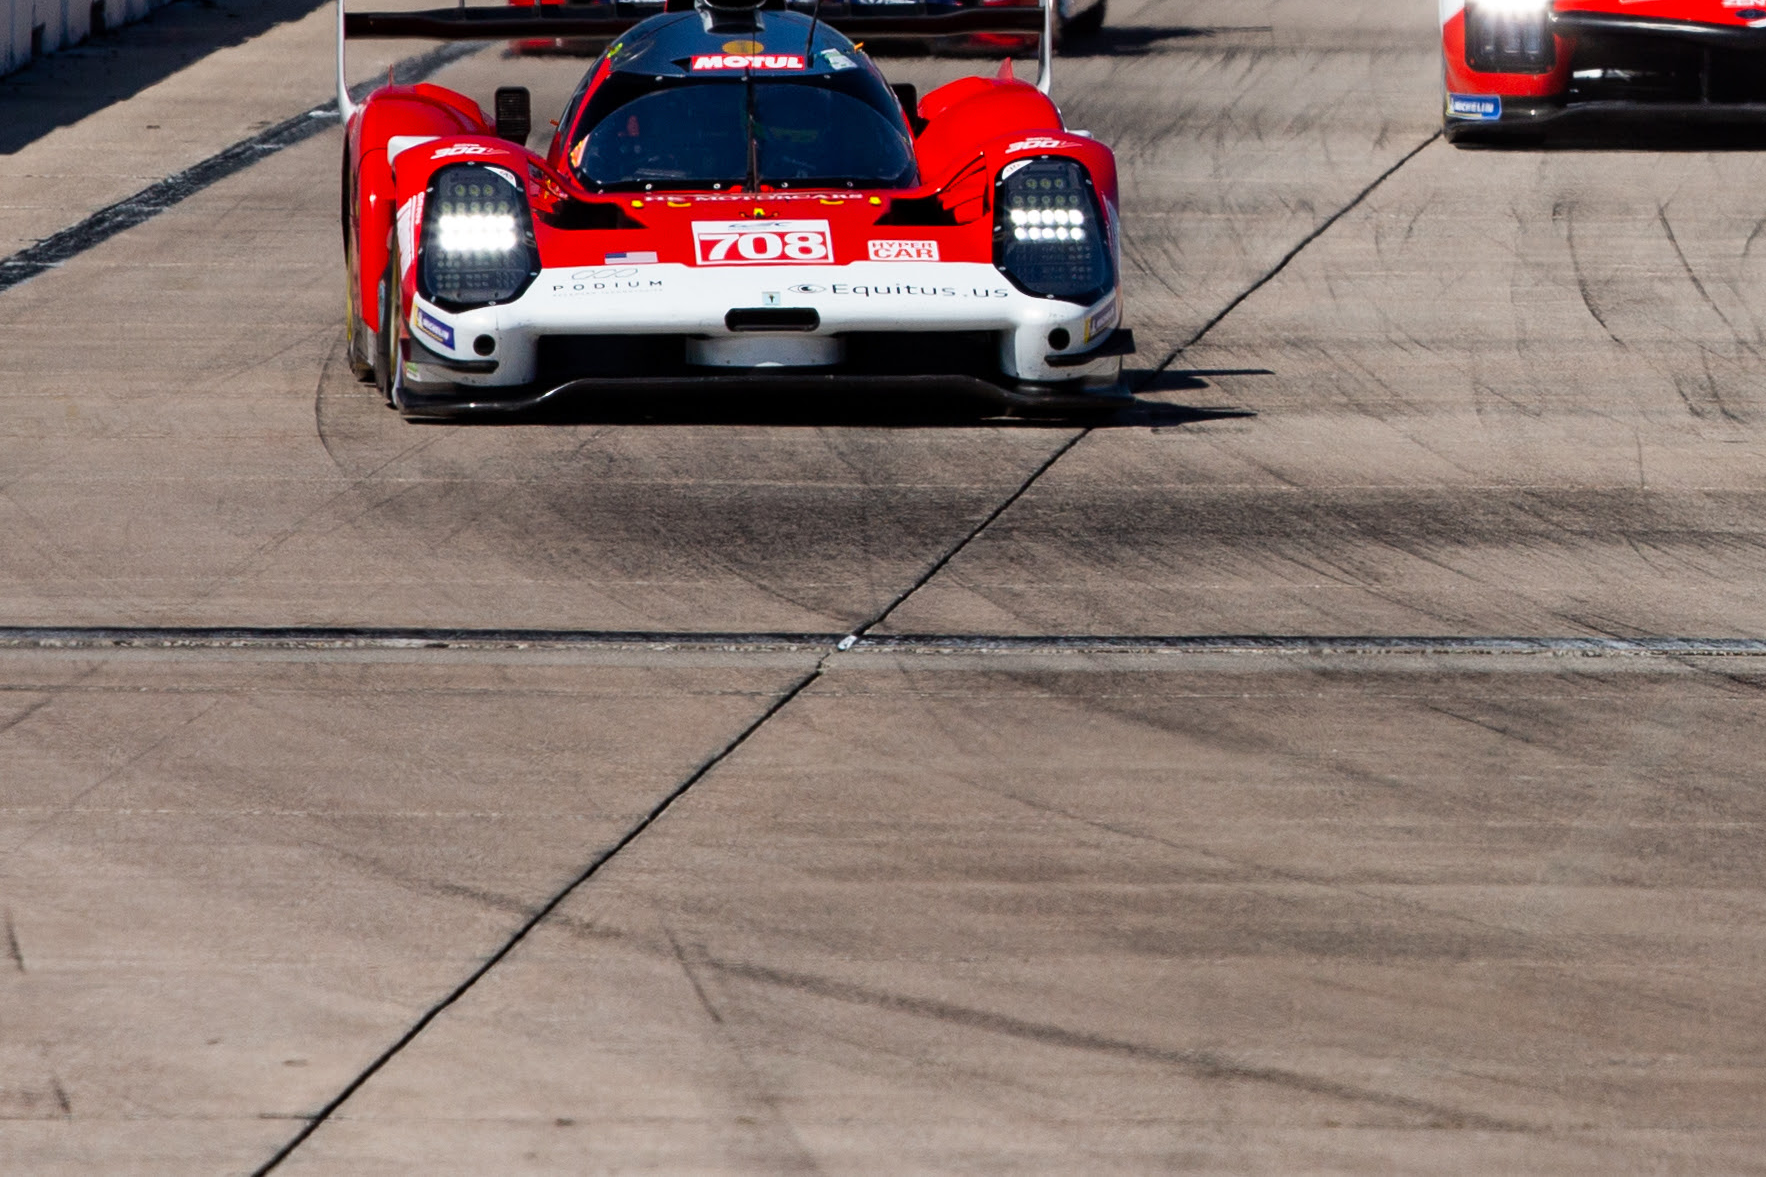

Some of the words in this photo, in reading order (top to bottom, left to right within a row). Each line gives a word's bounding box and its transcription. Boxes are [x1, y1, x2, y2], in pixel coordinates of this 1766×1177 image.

[693, 55, 803, 69] MOTUL
[698, 232, 828, 261] 708
[872, 241, 934, 249] HYPER
[873, 248, 935, 260] CAR
[552, 280, 663, 291] PODIUM
[831, 282, 1009, 298] Equitus.us
